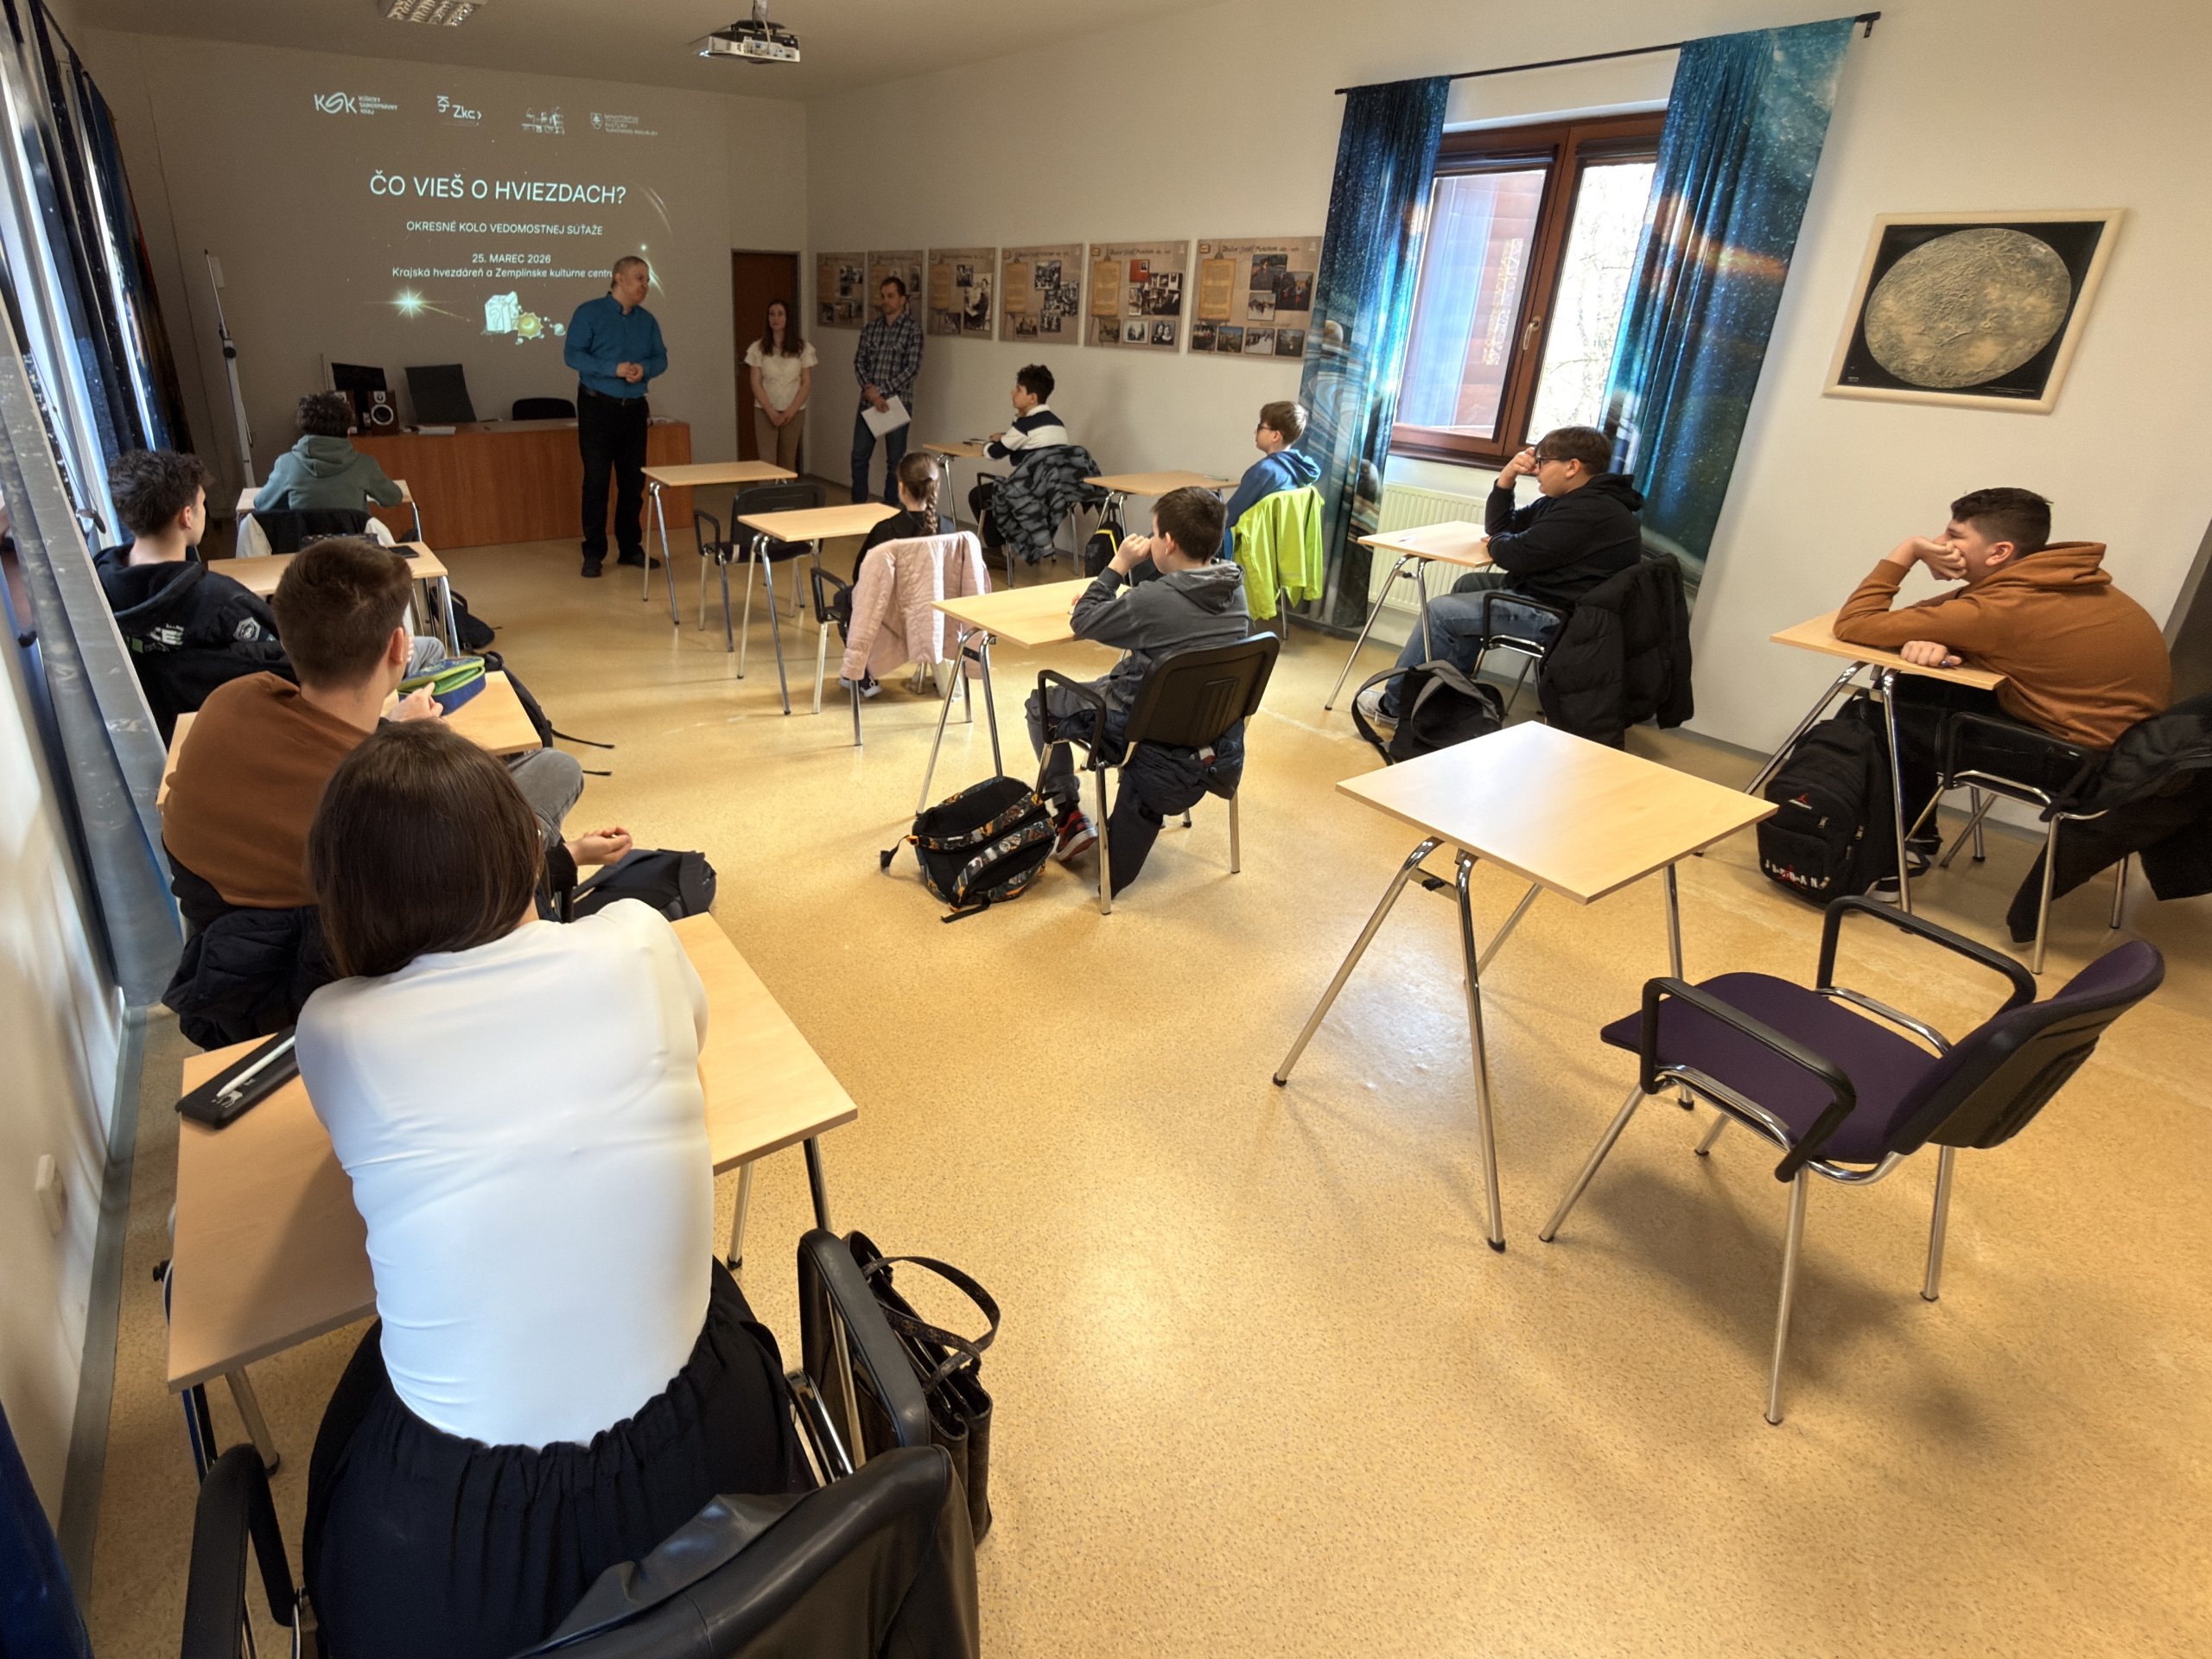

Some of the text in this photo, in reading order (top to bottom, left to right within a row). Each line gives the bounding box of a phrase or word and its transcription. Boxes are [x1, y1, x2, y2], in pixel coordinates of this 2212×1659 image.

[370, 169, 627, 205] ČO VIEŠ O HVIEZDACH?
[407, 220, 457, 232] OKRESNÉ
[459, 222, 487, 233] KOLO
[489, 222, 565, 235] VEDOMOSTNEJ
[472, 253, 551, 264] 25. MAREC 2026
[392, 267, 430, 279] Krajská
[433, 267, 484, 277] hvezdáreň
[486, 269, 493, 277] a
